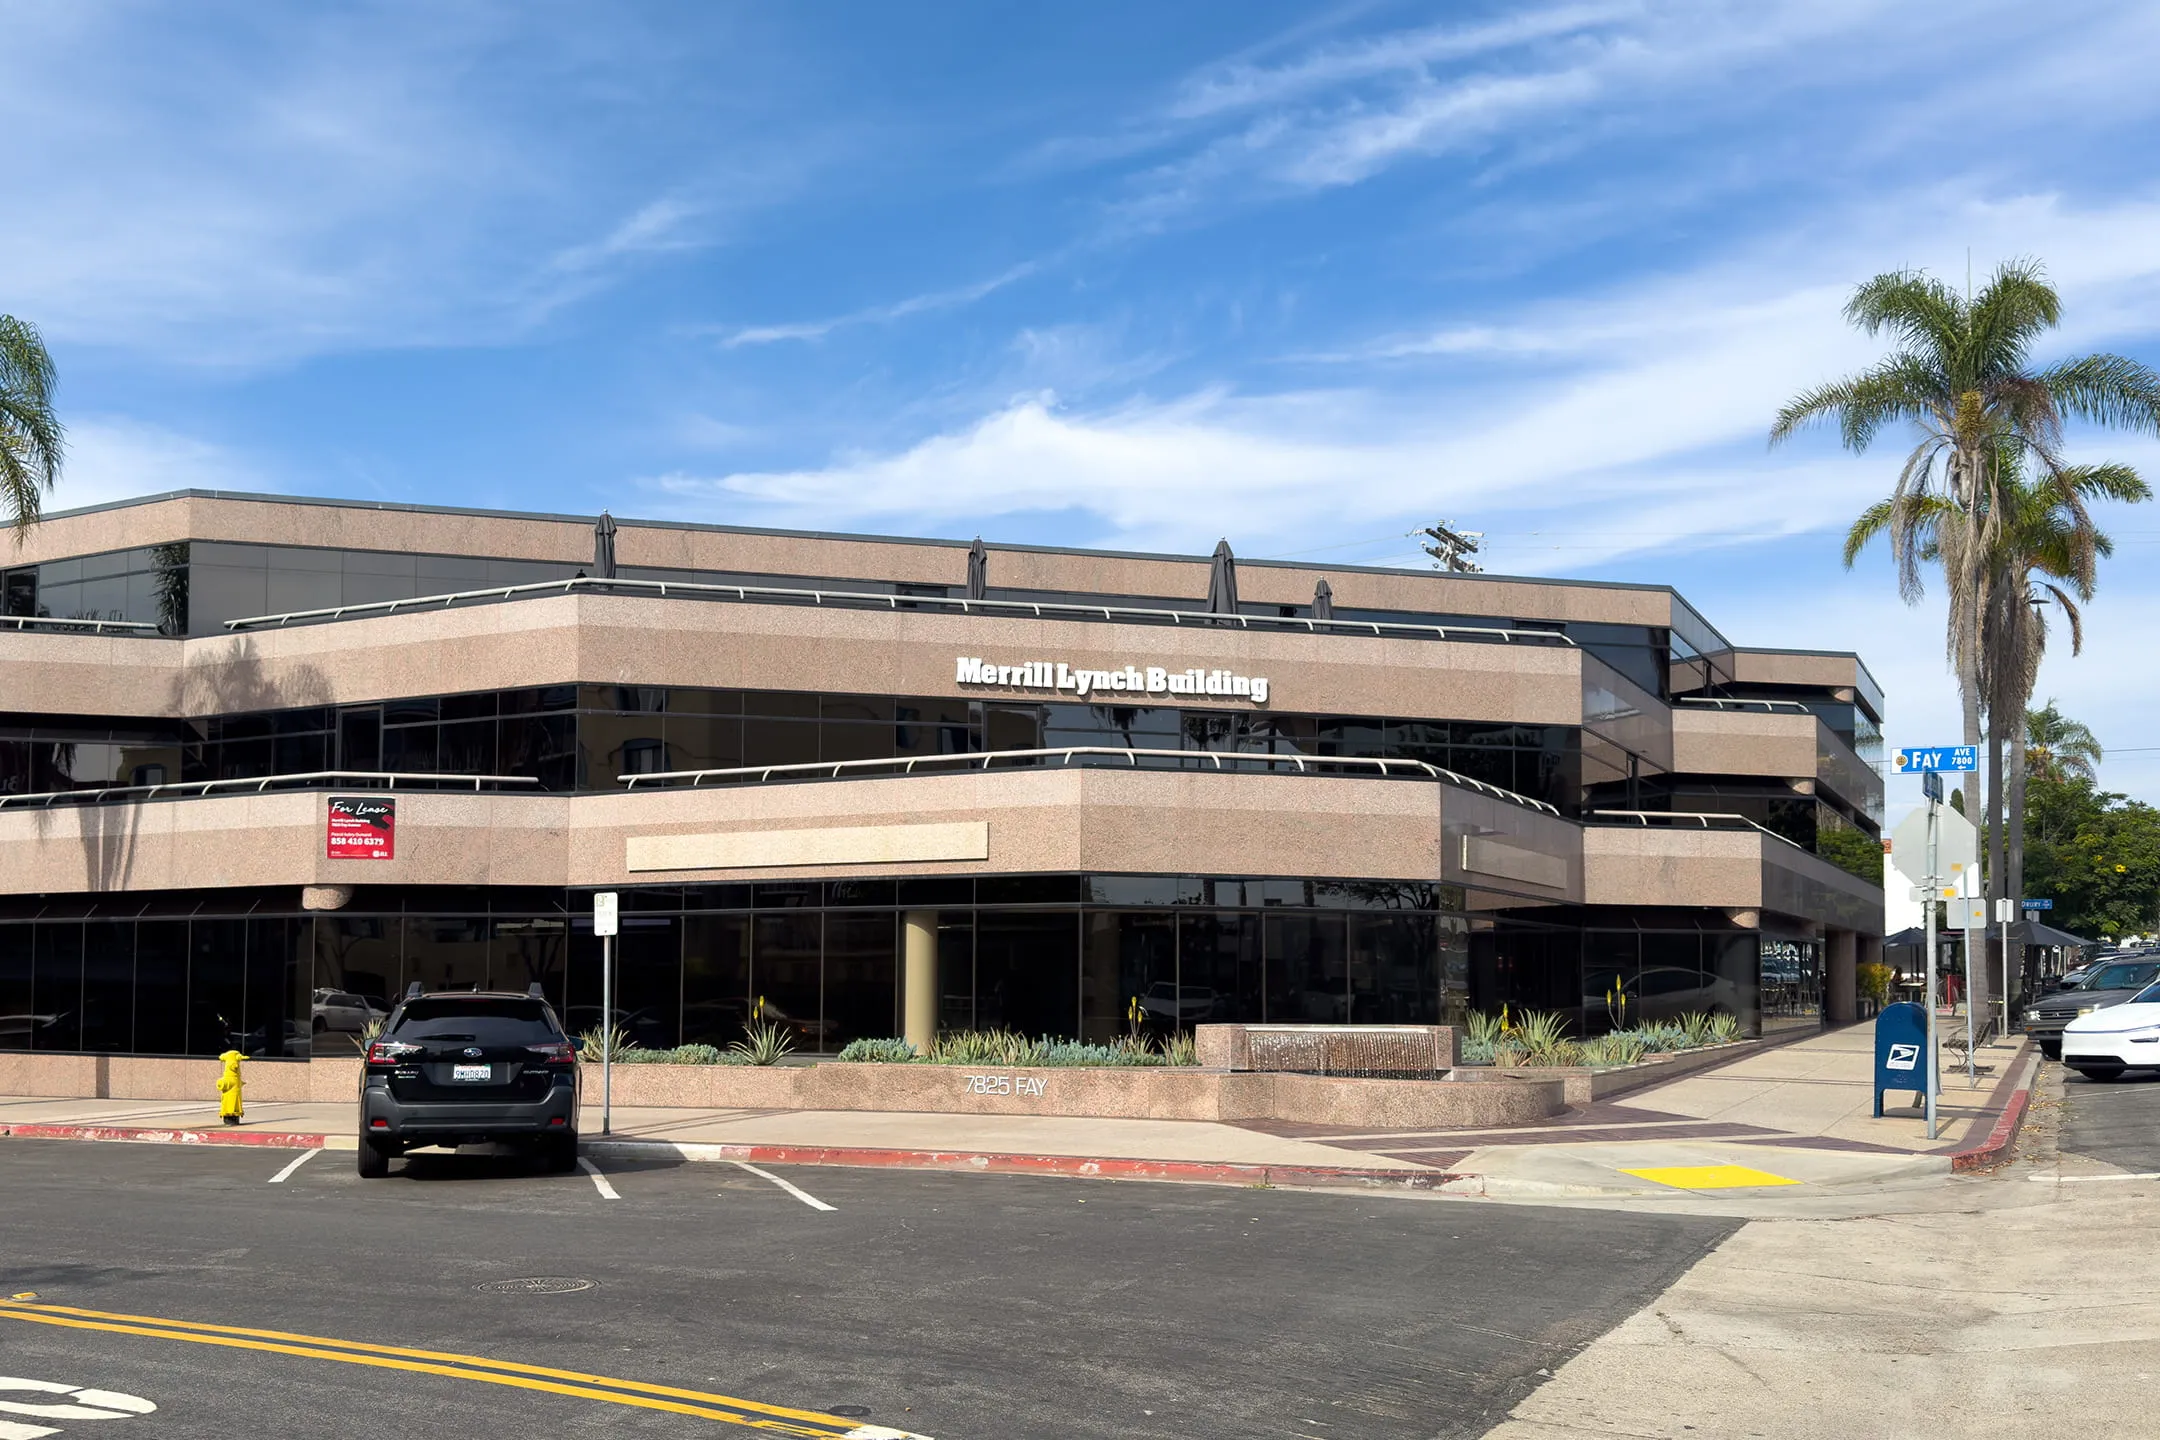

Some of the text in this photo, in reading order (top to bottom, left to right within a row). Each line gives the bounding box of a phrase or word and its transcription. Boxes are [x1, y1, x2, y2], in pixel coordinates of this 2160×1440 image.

[956, 657, 1269, 703] Merrill Lynch Building
[1912, 747, 1971, 769] FAY AVE
[1951, 756, 1973, 765] 7800
[331, 801, 389, 816] For Lease
[331, 837, 385, 846] 858 410 6379
[964, 1075, 1048, 1097] 7825 FAY
